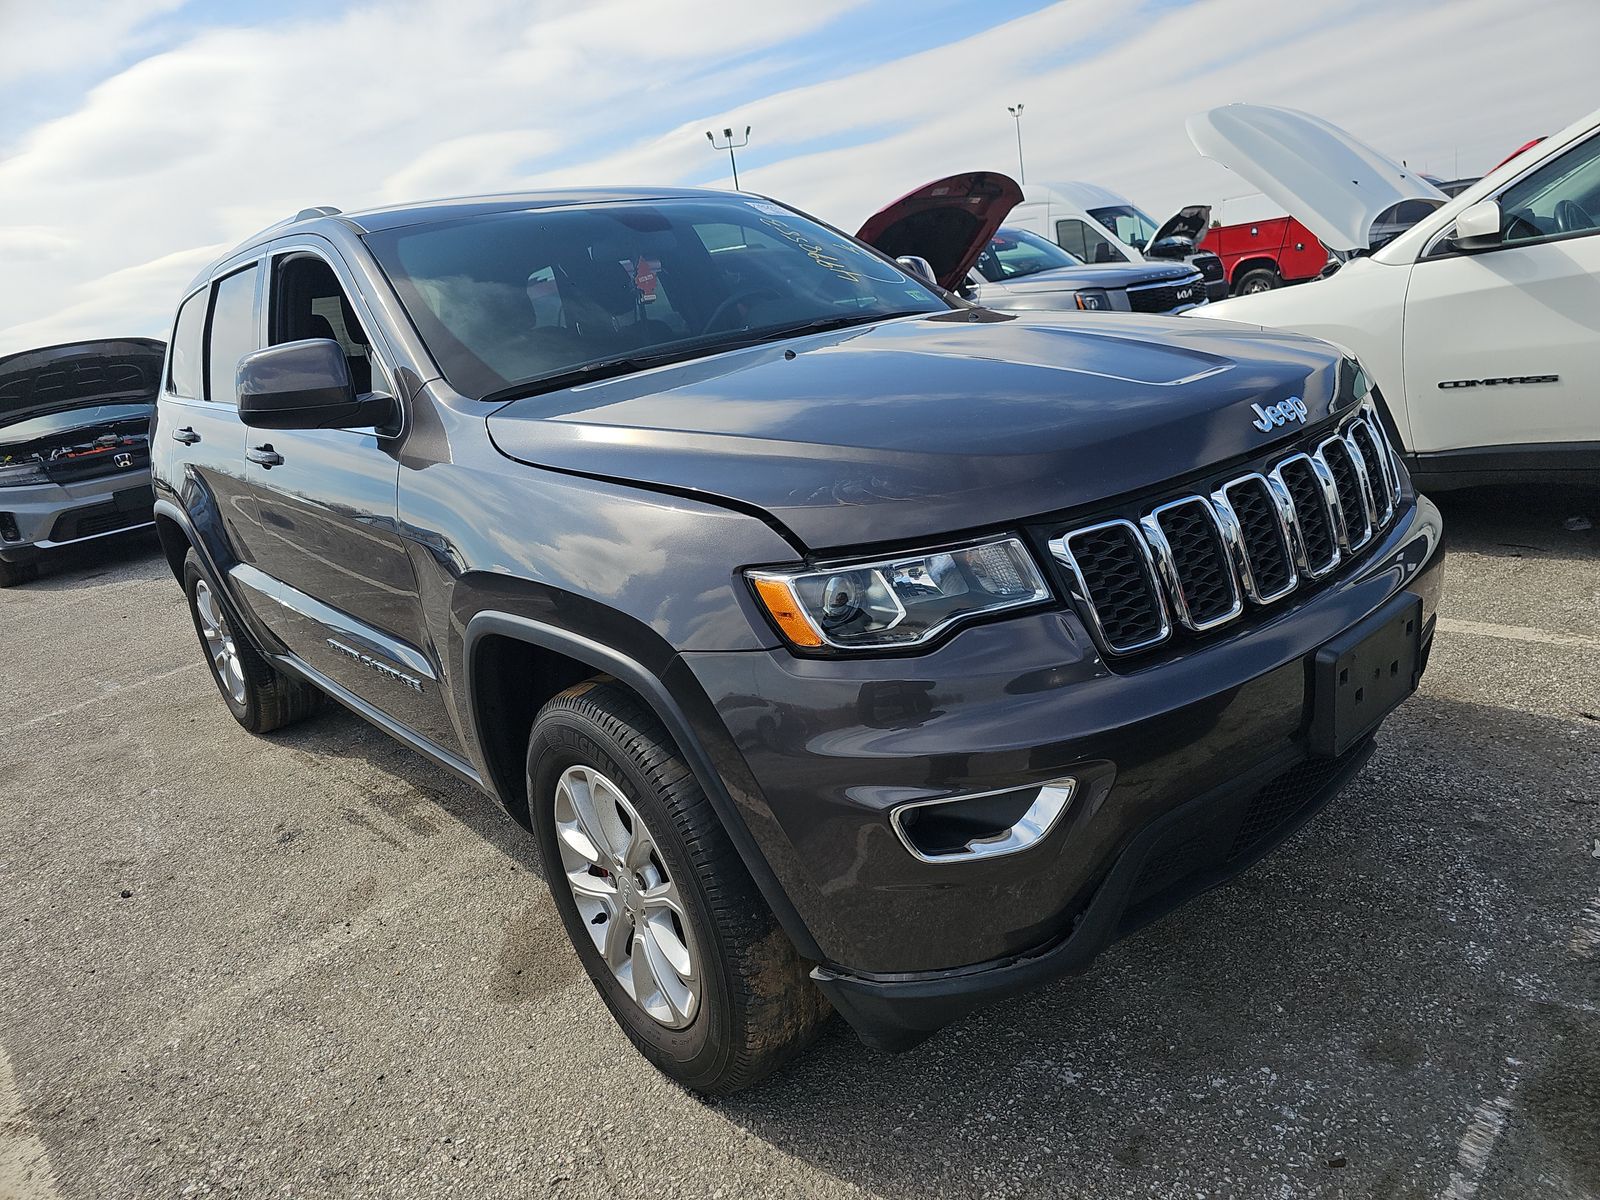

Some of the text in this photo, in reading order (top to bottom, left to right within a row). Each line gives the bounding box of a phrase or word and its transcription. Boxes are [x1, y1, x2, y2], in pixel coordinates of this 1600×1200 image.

[1438, 375, 1558, 388] COMPASS
[1250, 396, 1308, 433] Jeep
[562, 728, 638, 800] MICHELIN
